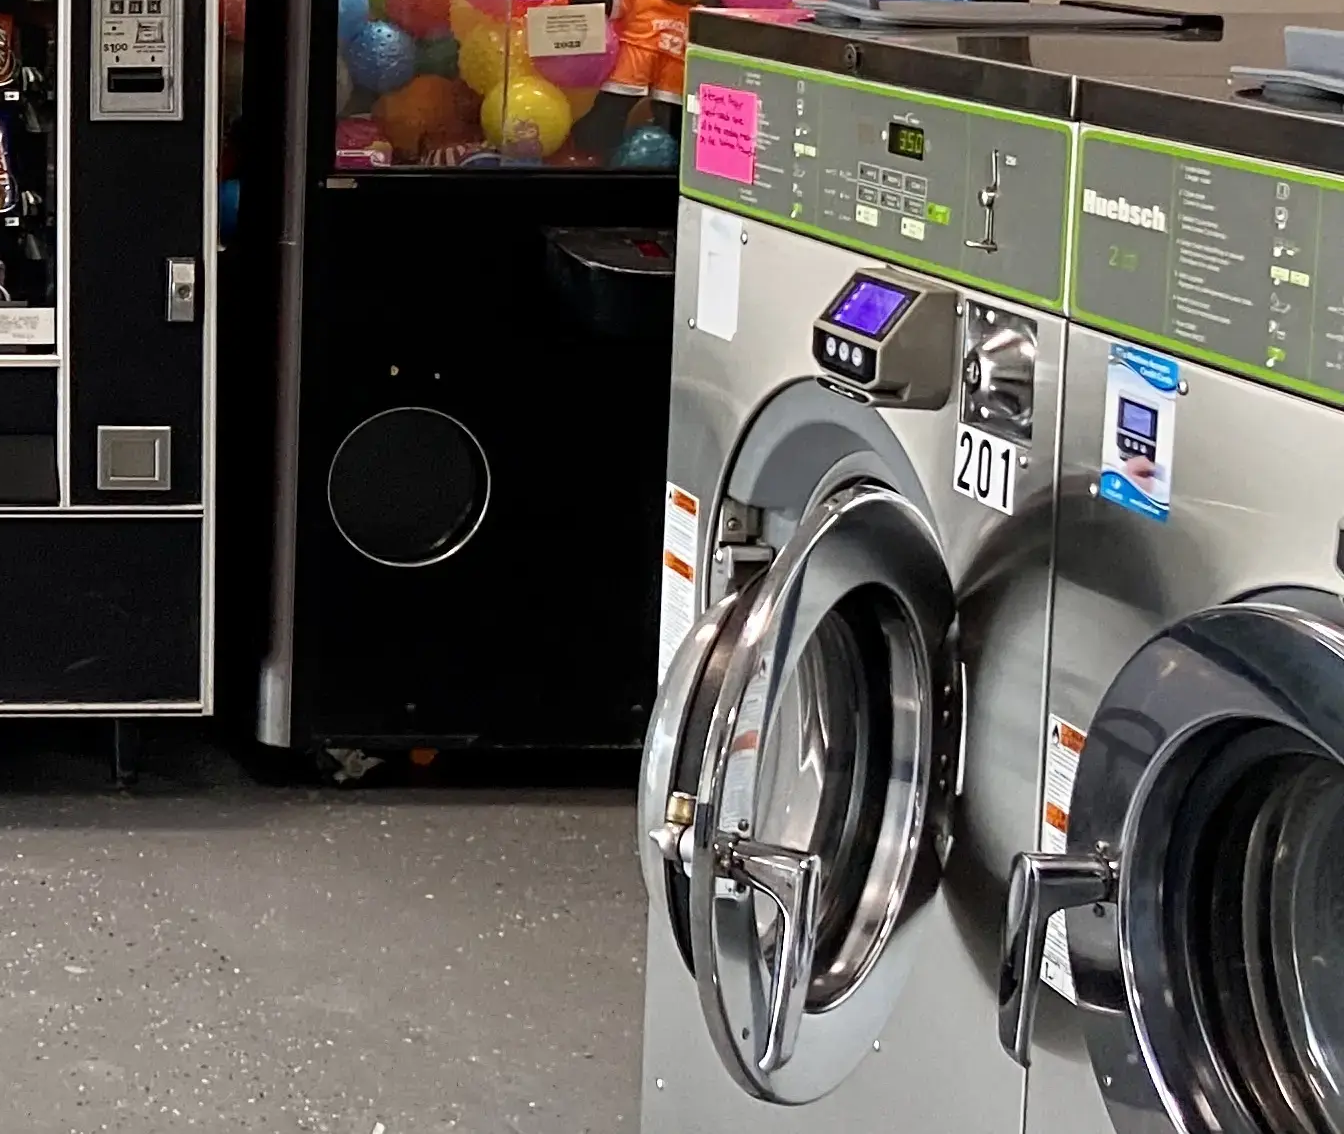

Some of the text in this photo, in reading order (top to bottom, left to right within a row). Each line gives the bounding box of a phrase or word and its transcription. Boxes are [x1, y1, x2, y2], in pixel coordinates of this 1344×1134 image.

[554, 41, 581, 49] 2022
[1082, 189, 1167, 233] Huebsch
[957, 431, 1011, 510] 201
